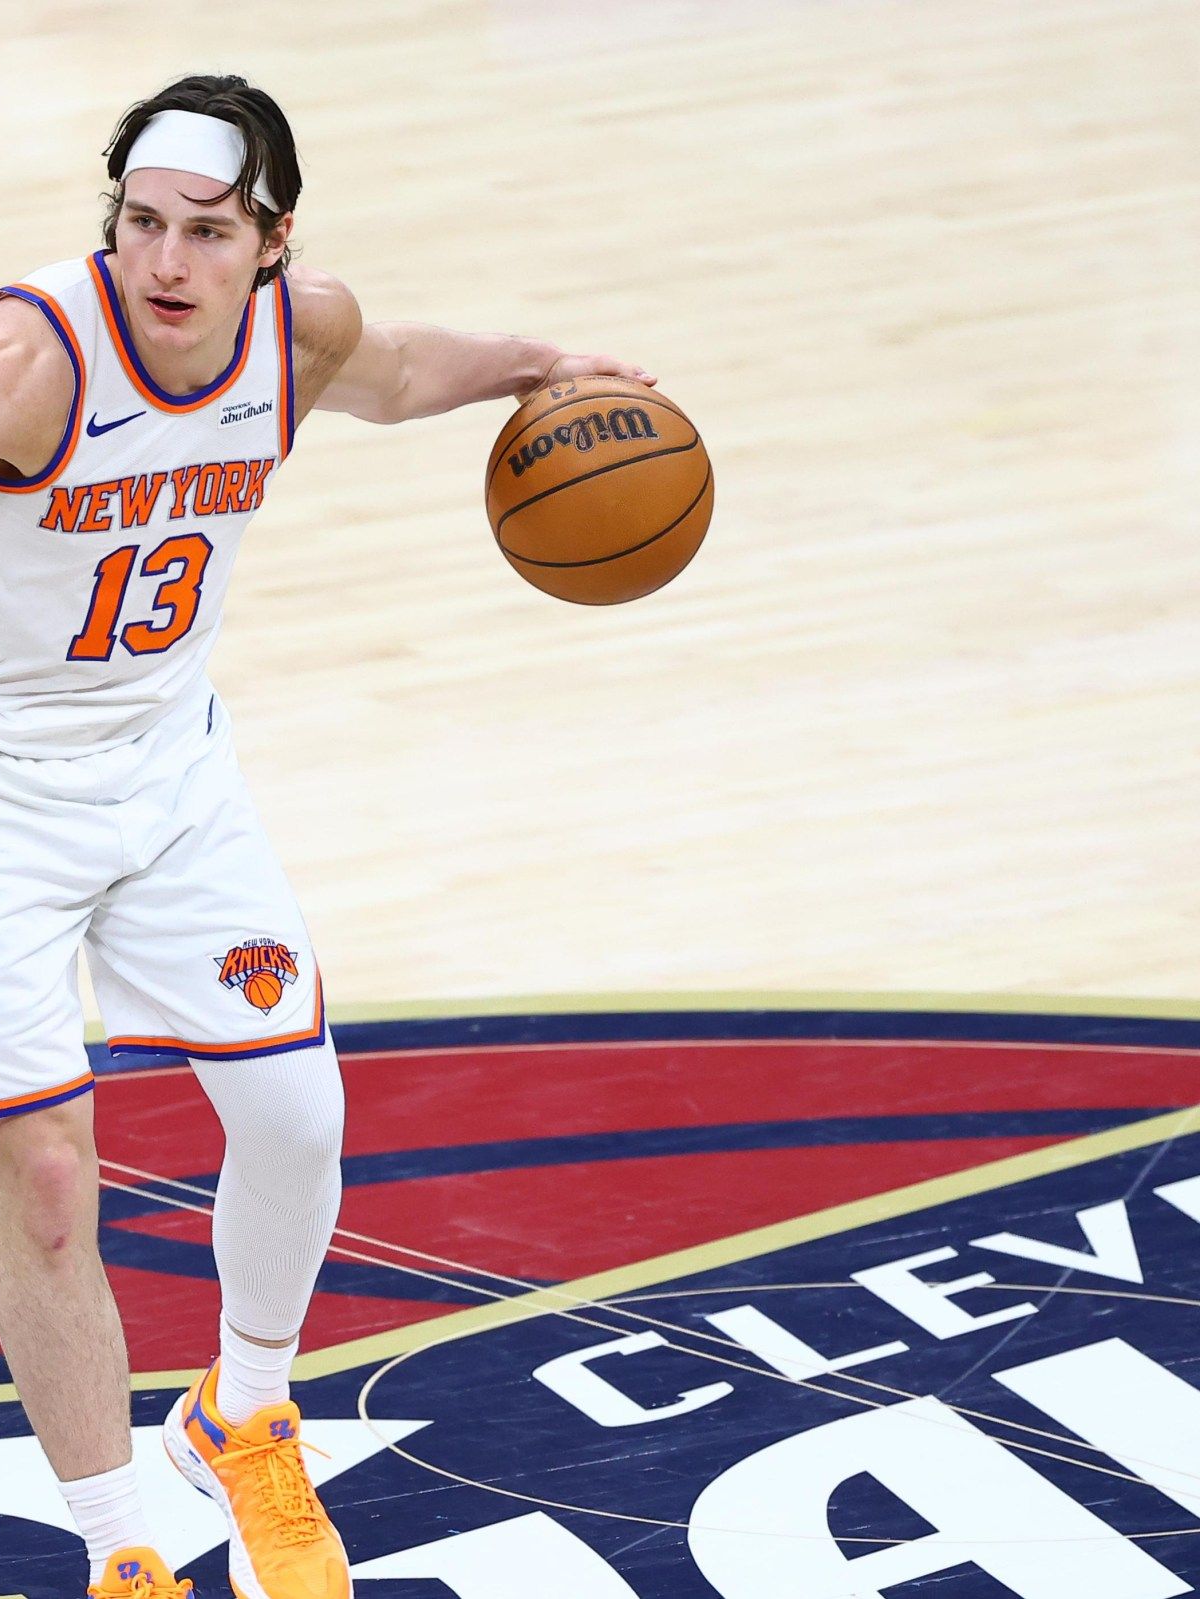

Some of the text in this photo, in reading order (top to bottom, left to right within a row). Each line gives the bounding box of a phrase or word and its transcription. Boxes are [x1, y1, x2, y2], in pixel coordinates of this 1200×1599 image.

[220, 399, 273, 425] abu dhabi
[507, 406, 660, 478] Wilson
[39, 456, 277, 534] NEW YORK
[66, 532, 214, 662] 13
[218, 943, 299, 984] KNICKS
[243, 937, 276, 948] NEW YORK
[532, 1174, 1200, 1428] CLEV
